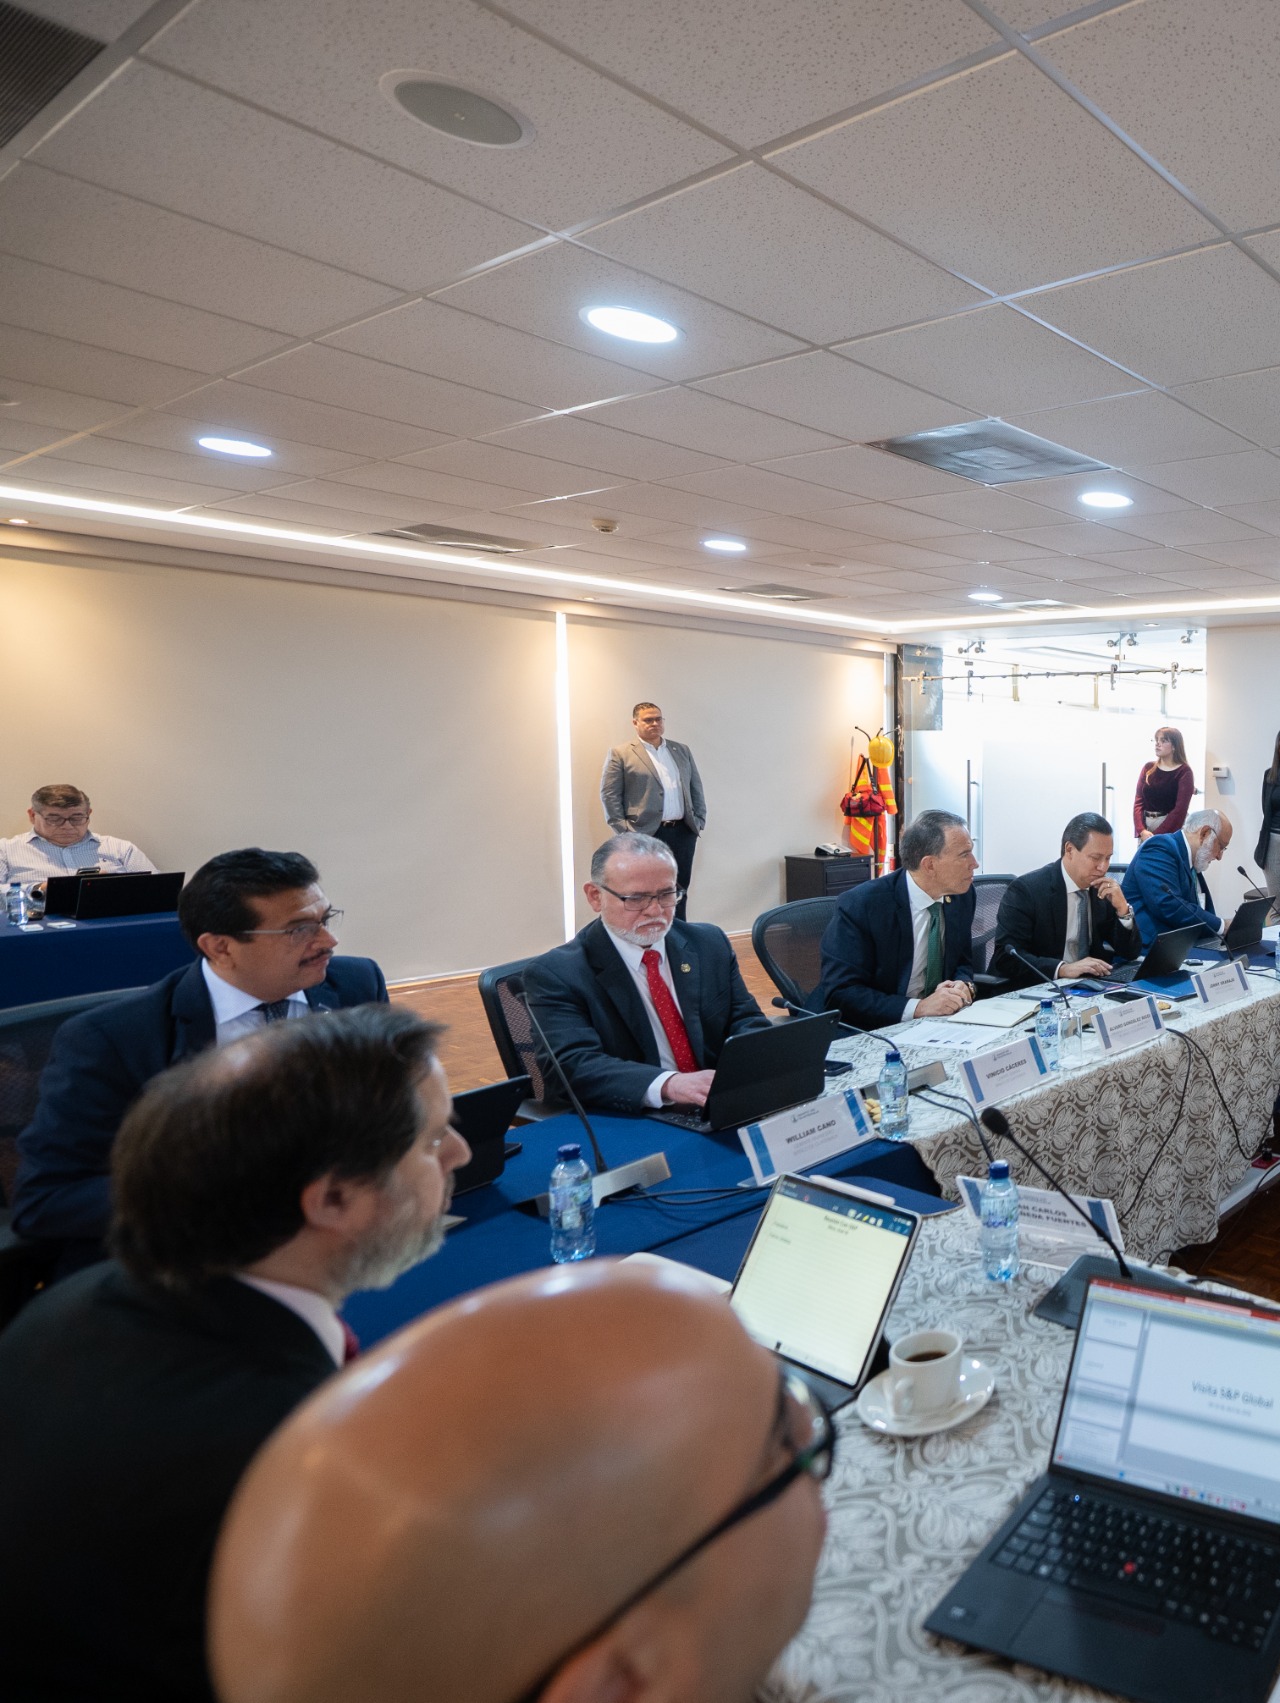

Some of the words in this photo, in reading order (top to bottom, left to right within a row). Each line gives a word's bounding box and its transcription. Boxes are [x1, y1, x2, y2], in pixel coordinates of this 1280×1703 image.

[785, 1126, 817, 1144] WILLIAM
[816, 1119, 837, 1133] CANO
[1031, 1206, 1068, 1218] CARLOS
[1046, 1214, 1087, 1228] FUENTES
